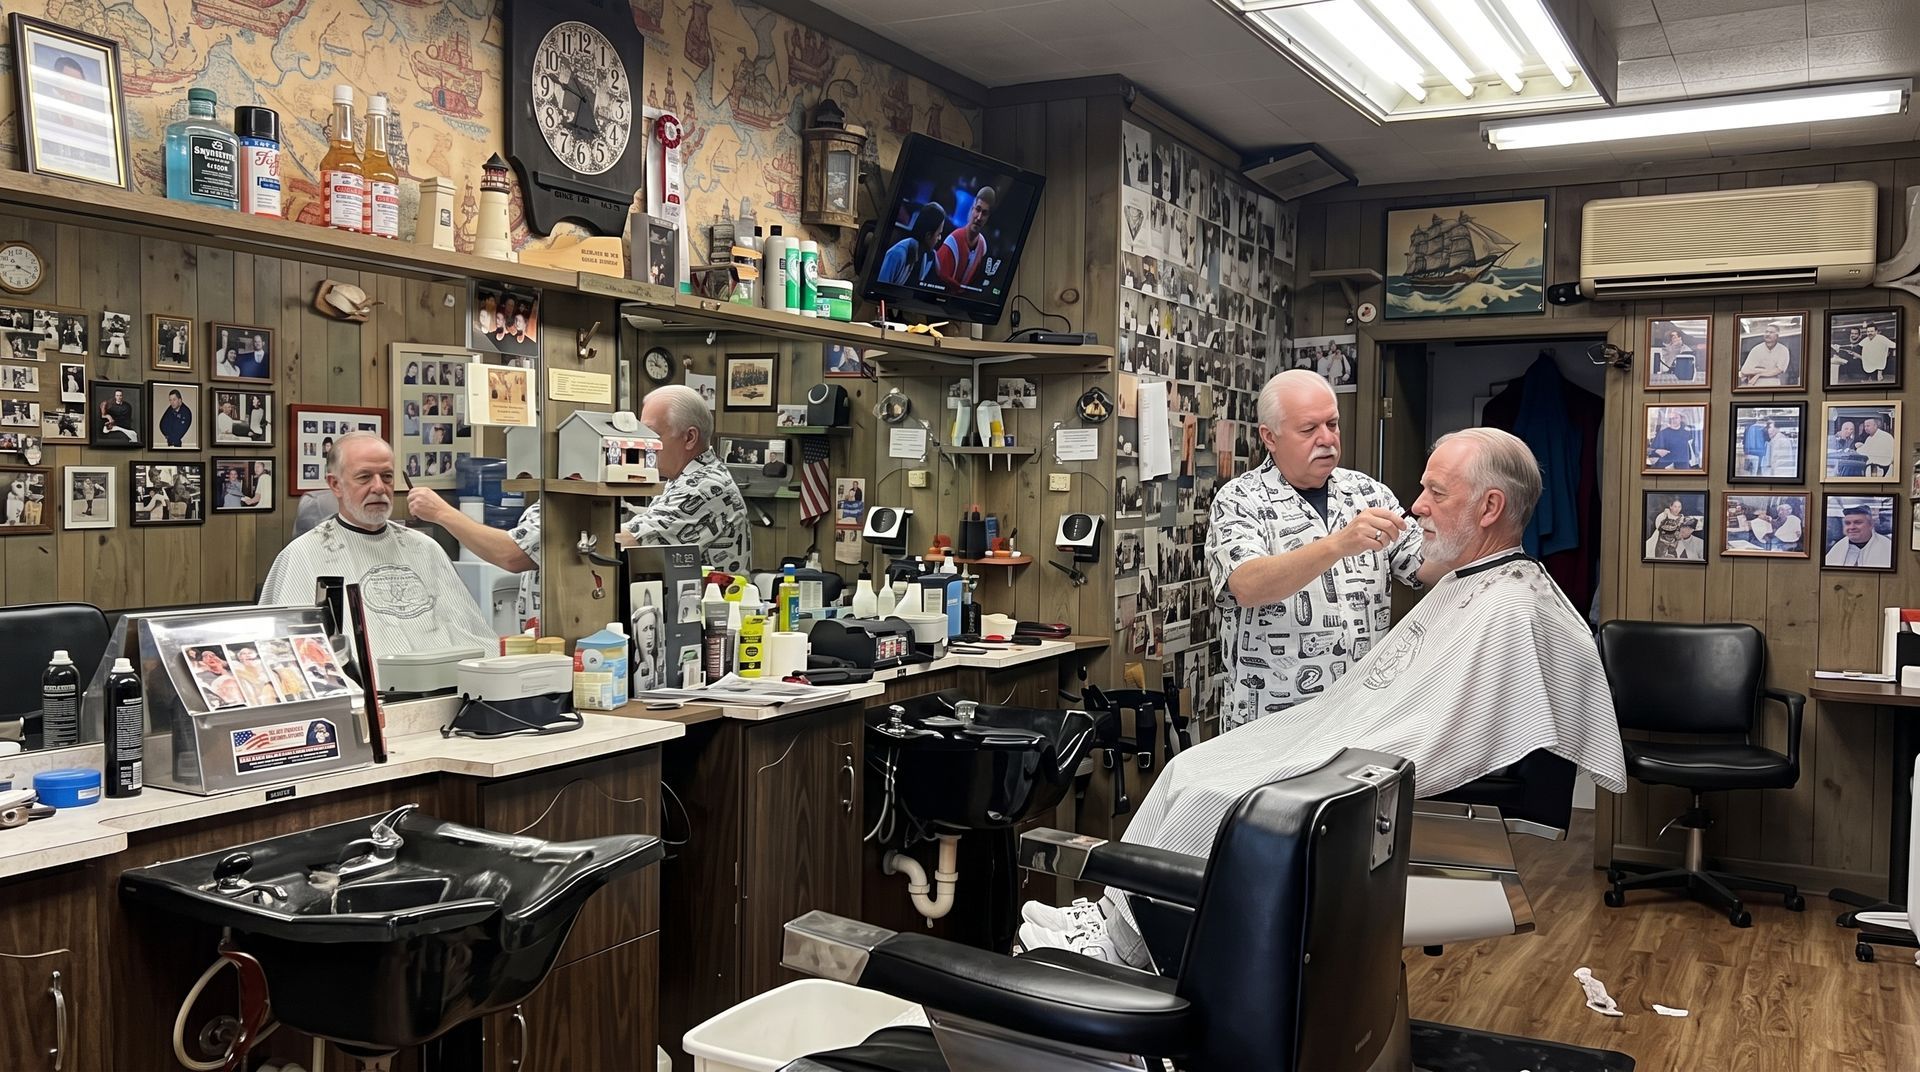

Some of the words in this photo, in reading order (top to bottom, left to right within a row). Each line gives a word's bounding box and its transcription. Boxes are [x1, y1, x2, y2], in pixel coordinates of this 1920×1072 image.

[561, 31, 571, 54] 11
[578, 31, 591, 54] 12
[545, 48, 558, 72] 10
[600, 46, 606, 67] 1
[540, 75, 550, 97] 9
[611, 69, 620, 91] 2
[545, 106, 555, 128] 8
[615, 99, 624, 120] 3
[560, 131, 569, 153] 7
[608, 125, 618, 146] 4
[576, 143, 586, 165] 6
[595, 142, 605, 163] 5
